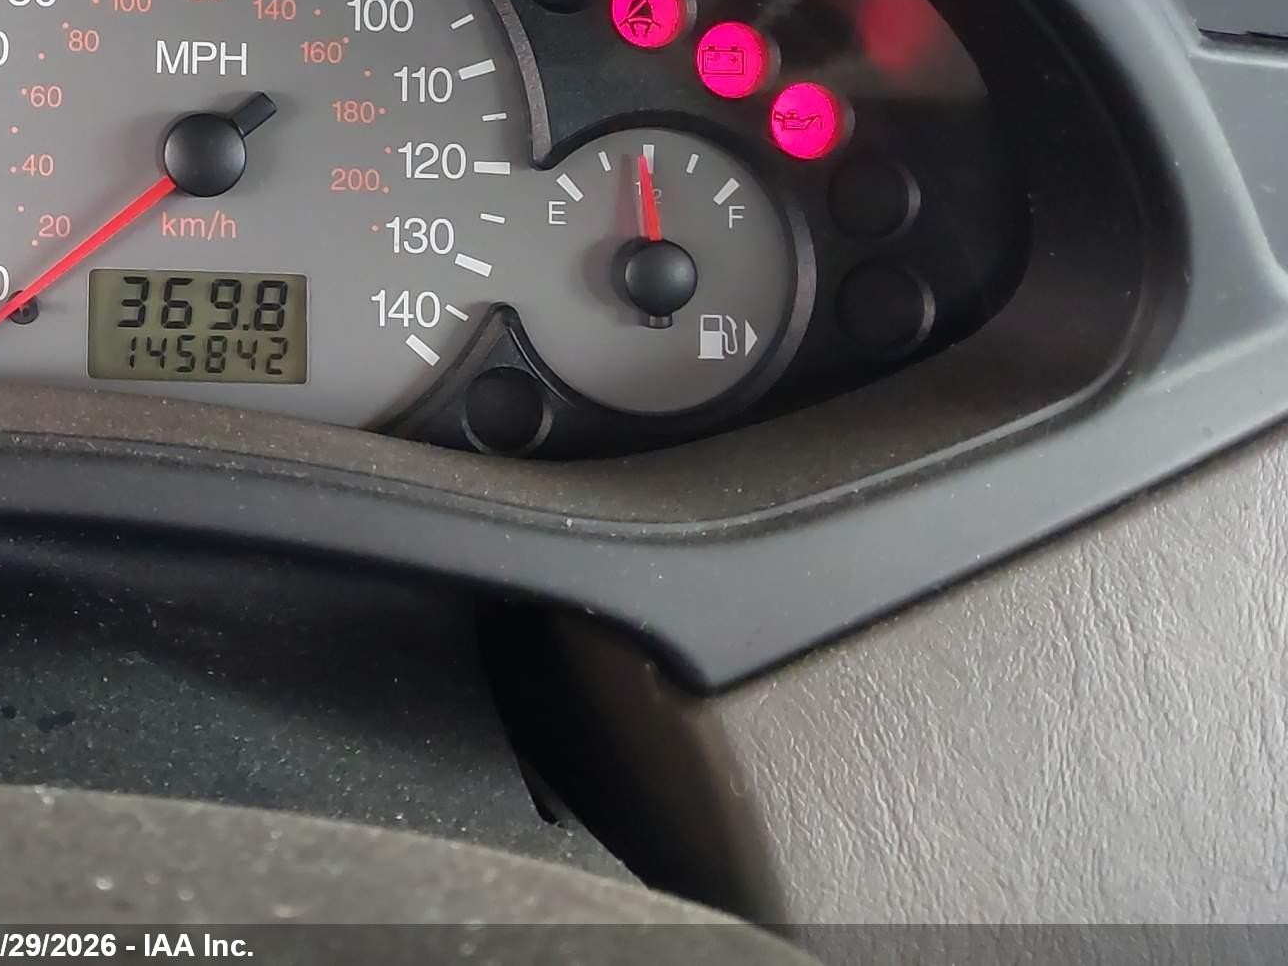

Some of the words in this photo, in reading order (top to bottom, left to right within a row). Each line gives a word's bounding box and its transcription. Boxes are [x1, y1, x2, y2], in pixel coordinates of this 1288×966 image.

[68, 30, 99, 52] 80
[300, 41, 342, 64] 160
[156, 41, 248, 75] MPH
[30, 85, 62, 107] 60
[393, 67, 453, 102] 110
[332, 101, 375, 123] 180
[22, 154, 53, 176] 40
[398, 143, 466, 178] 120
[330, 168, 380, 191] 200
[549, 202, 566, 224] E
[728, 206, 744, 228] F
[39, 215, 71, 237] 20
[162, 211, 237, 239] km/h
[386, 218, 455, 254] 130
[118, 277, 288, 331] 369.8
[371, 291, 440, 326] 140
[128, 336, 288, 374] 145842
